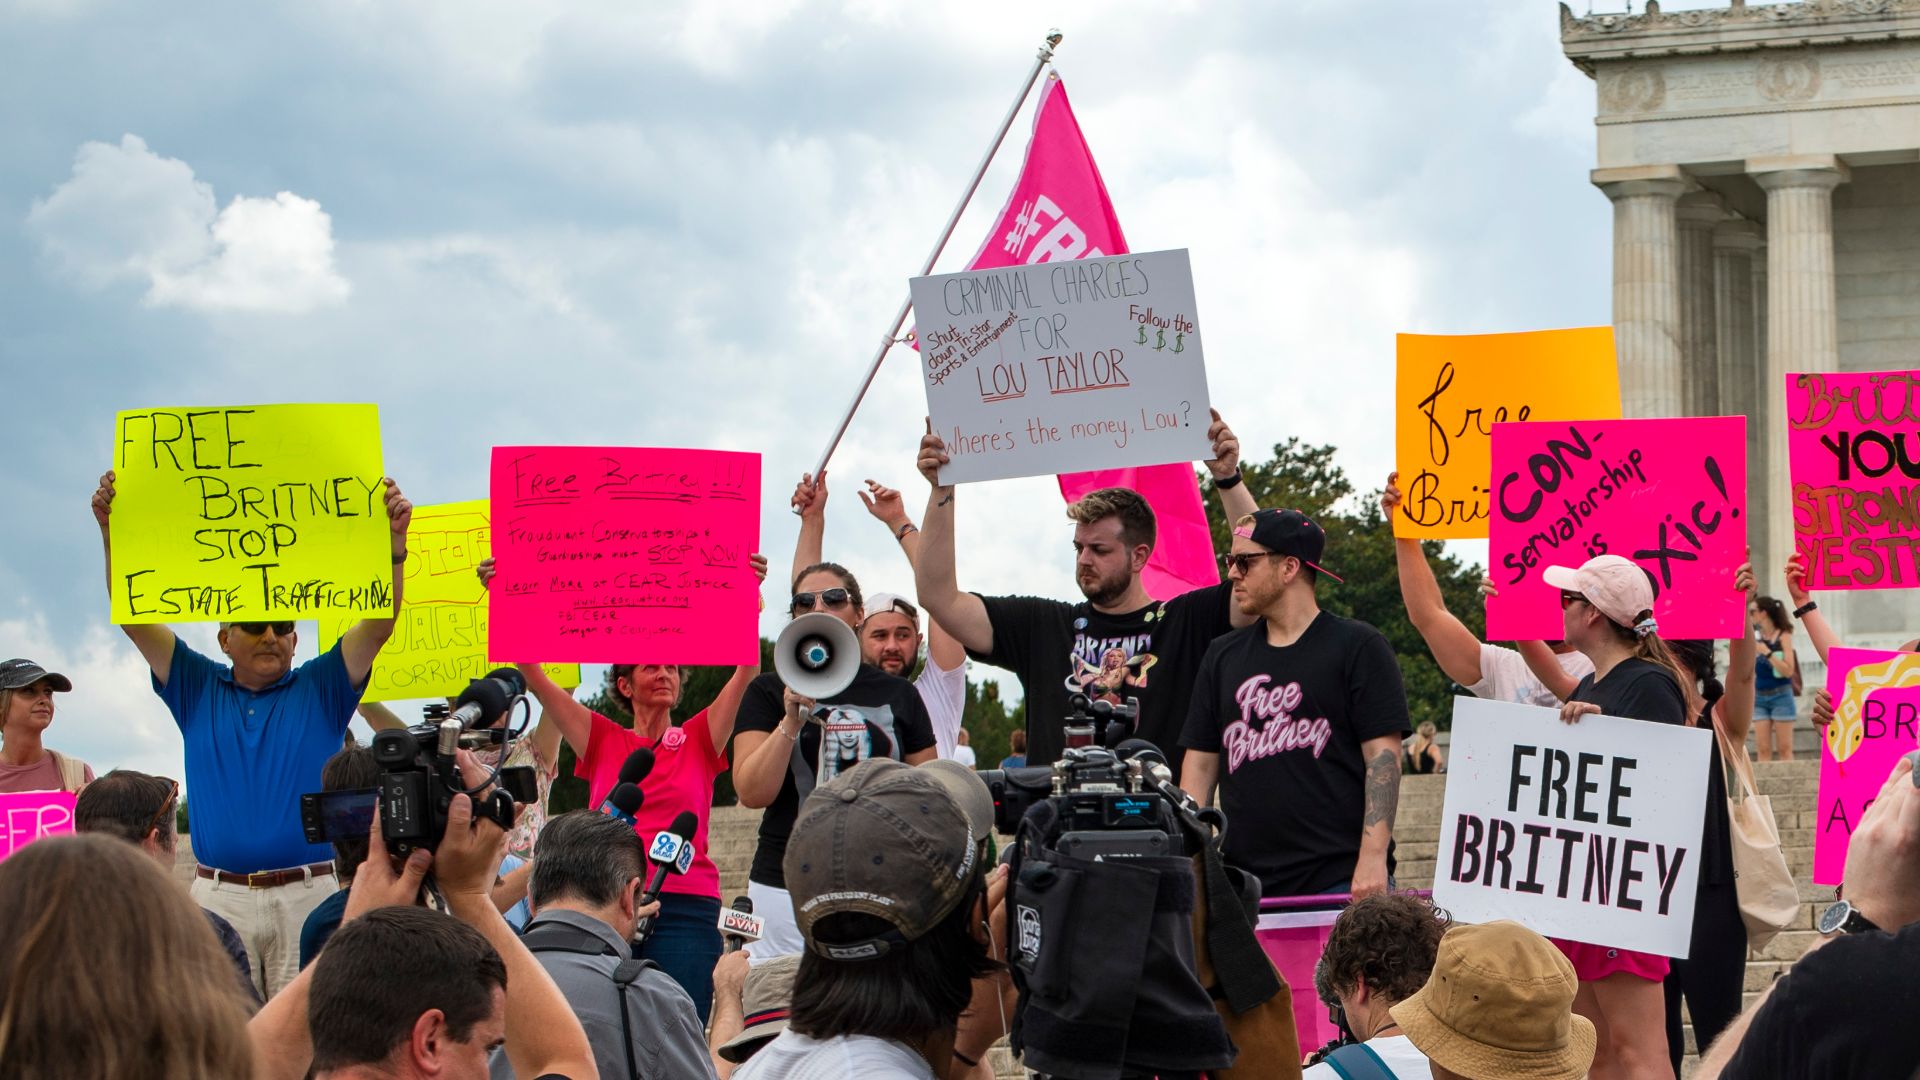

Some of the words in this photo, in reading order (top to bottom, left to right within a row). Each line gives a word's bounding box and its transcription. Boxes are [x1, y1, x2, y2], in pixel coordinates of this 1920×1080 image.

[1004, 194, 1106, 265] #FR
[943, 271, 1042, 317] CRIMINAL
[1050, 259, 1149, 304] CHARGES
[926, 323, 960, 350] Shut
[967, 310, 1018, 357] Entertainment
[1018, 313, 1070, 351] FOR
[1129, 304, 1170, 328] Follow
[1174, 313, 1193, 333] the
[928, 345, 957, 369] down
[976, 362, 1027, 396] LOU
[1037, 349, 1129, 391] TAYLOR
[122, 409, 263, 471] FREE
[1025, 416, 1061, 445] the
[1499, 425, 1604, 523] CON-
[184, 475, 384, 521] BRITNEY
[1402, 469, 1490, 527] Bri
[194, 523, 297, 562] STOP
[648, 543, 694, 561] STOP
[1583, 533, 1608, 558] is
[125, 570, 245, 616] ESTATE
[614, 572, 671, 589] CEAR
[1235, 673, 1303, 723] Free
[1223, 711, 1331, 775] Britney
[1507, 744, 1638, 828] FREE
[1450, 813, 1687, 916] BRITNEY
[725, 916, 761, 933] DVM
[731, 912, 754, 921] LOCAL
